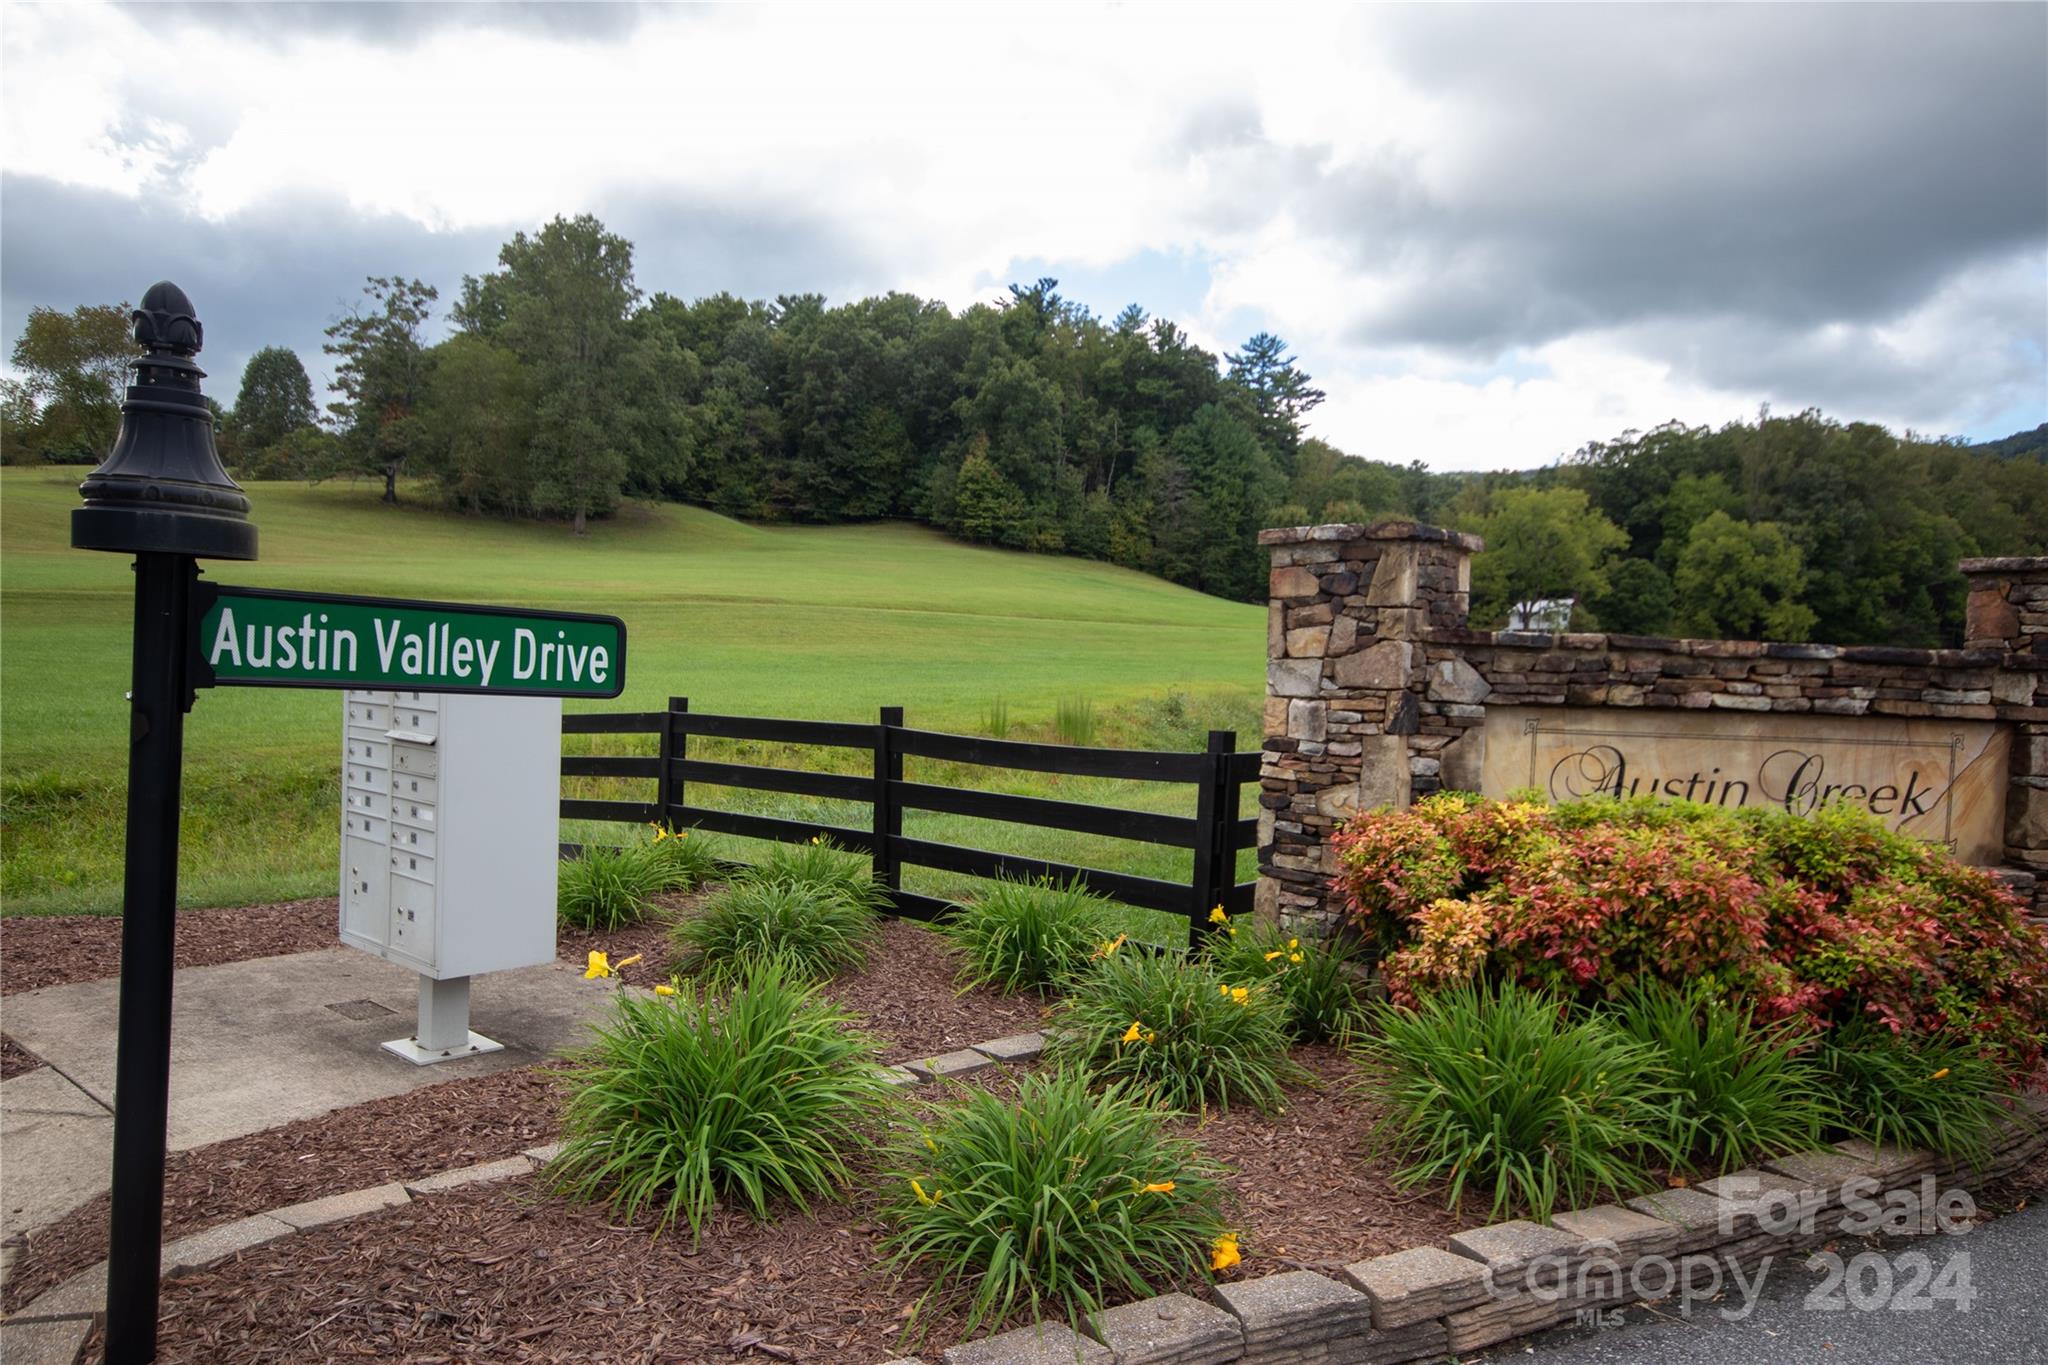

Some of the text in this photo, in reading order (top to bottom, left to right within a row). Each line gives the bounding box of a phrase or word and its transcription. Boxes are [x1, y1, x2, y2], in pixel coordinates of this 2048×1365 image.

[210, 608, 609, 687] Austin Valley Drive
[1550, 745, 1749, 807] Austin
